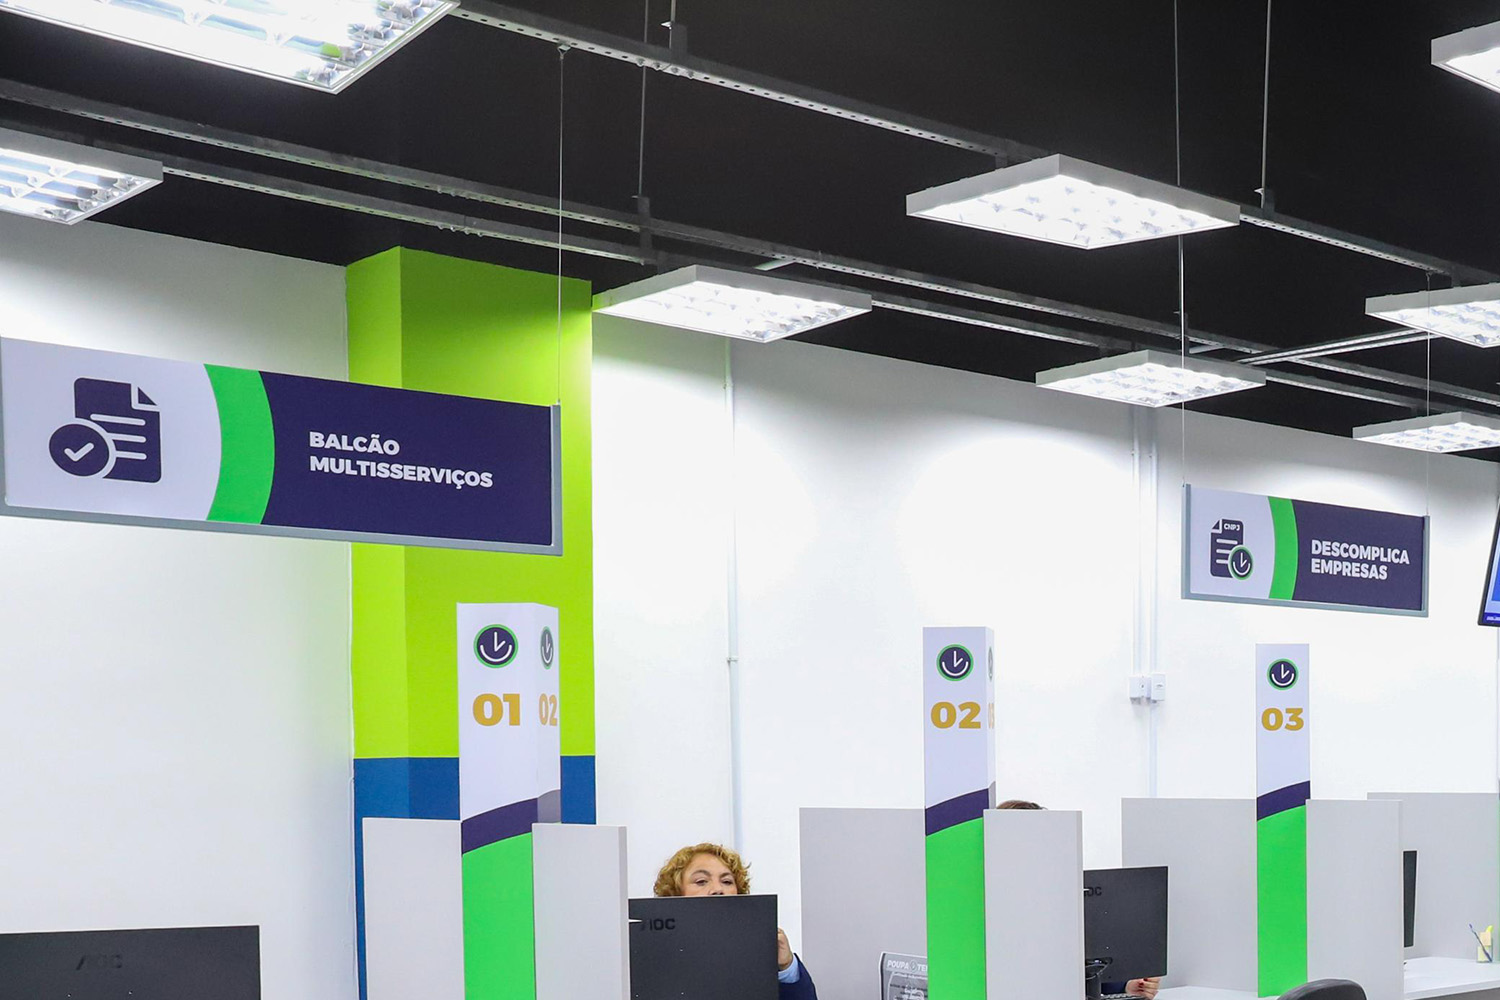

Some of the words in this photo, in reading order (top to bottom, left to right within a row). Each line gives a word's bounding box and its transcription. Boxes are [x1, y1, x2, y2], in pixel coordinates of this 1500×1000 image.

[309, 431, 400, 456] BALCÃO
[310, 456, 494, 489] MULTISSERVIÇOS
[1311, 539, 1410, 564] DESCOMPLICA
[1311, 558, 1388, 580] EMPRESAS
[472, 693, 520, 727] 01
[538, 693, 558, 726] 02
[930, 701, 981, 729] 02
[1261, 707, 1305, 731] 03
[887, 960, 909, 970] POUPA
